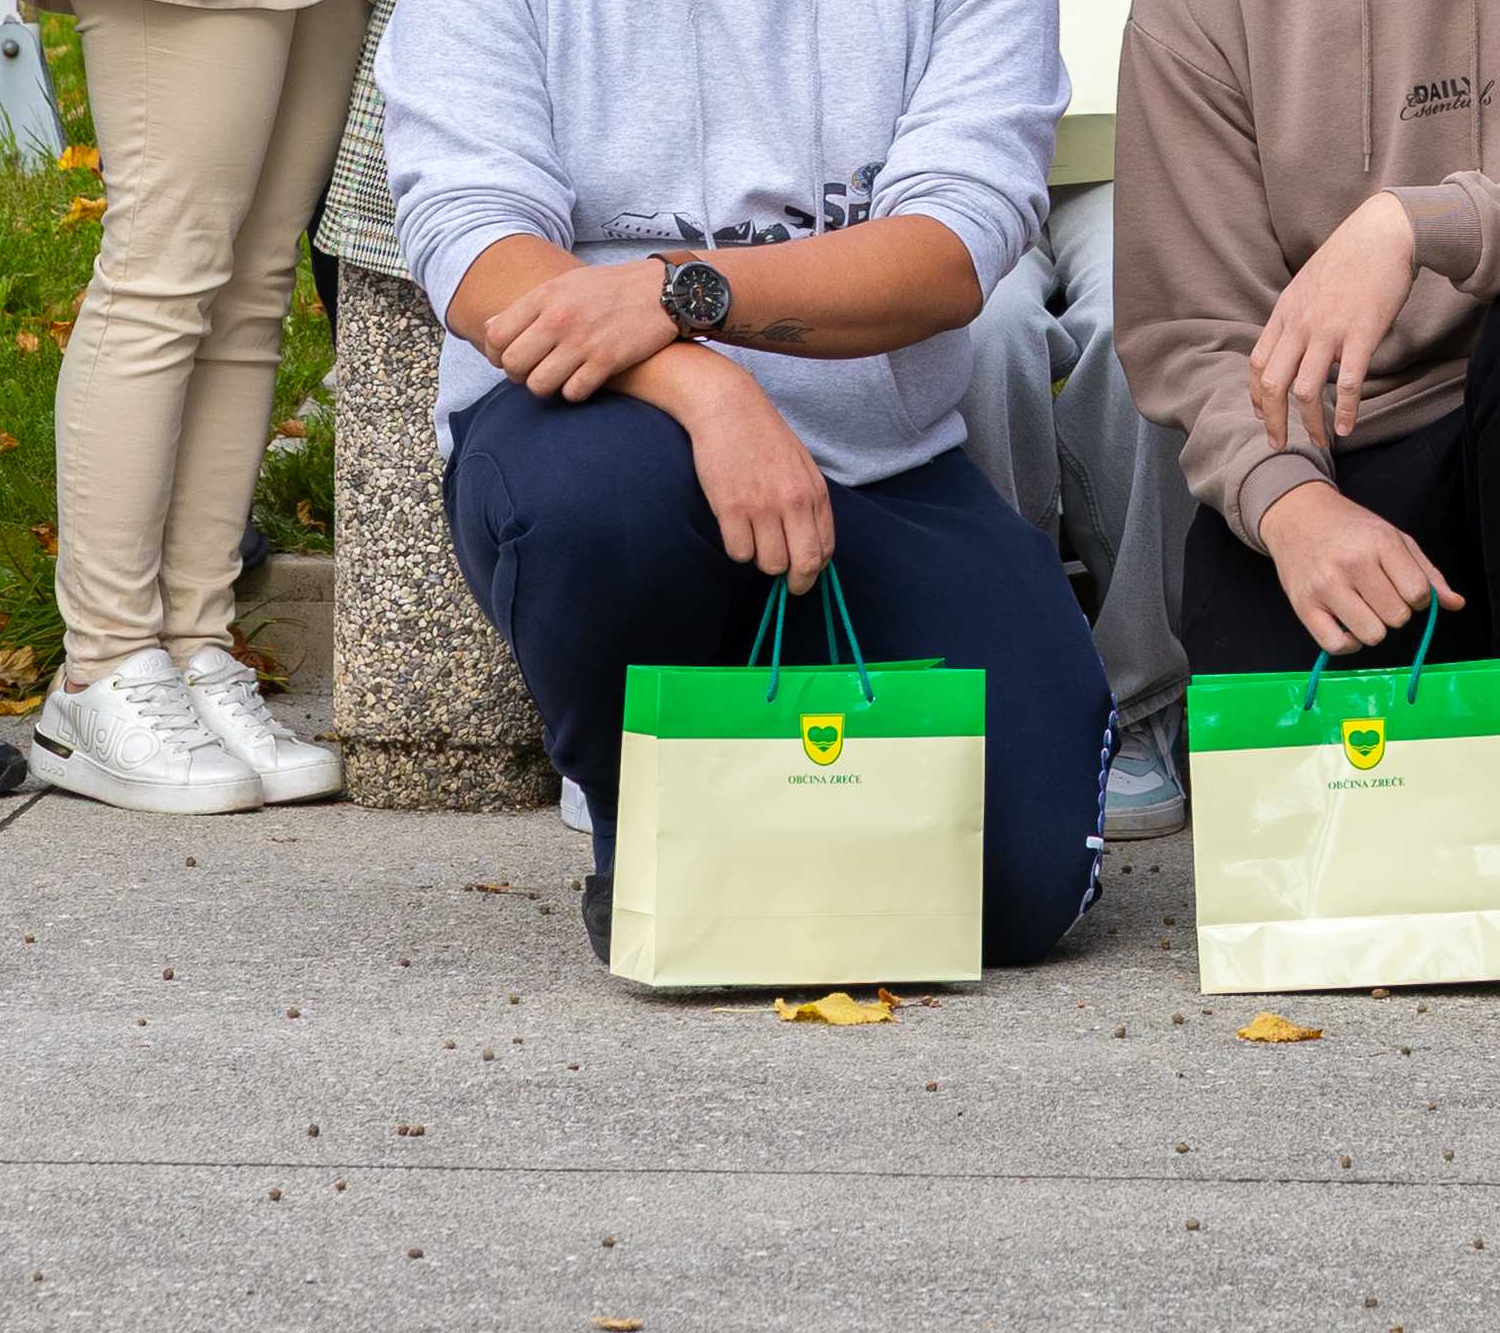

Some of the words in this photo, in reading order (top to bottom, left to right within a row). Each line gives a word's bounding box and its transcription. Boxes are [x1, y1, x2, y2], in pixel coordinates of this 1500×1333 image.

[1413, 76, 1472, 104] DAILY
[787, 773, 828, 785] OBČINA
[828, 773, 863, 785] ZREČE
[1327, 778, 1369, 790] OBČINA
[1371, 776, 1406, 788] ZREČE
